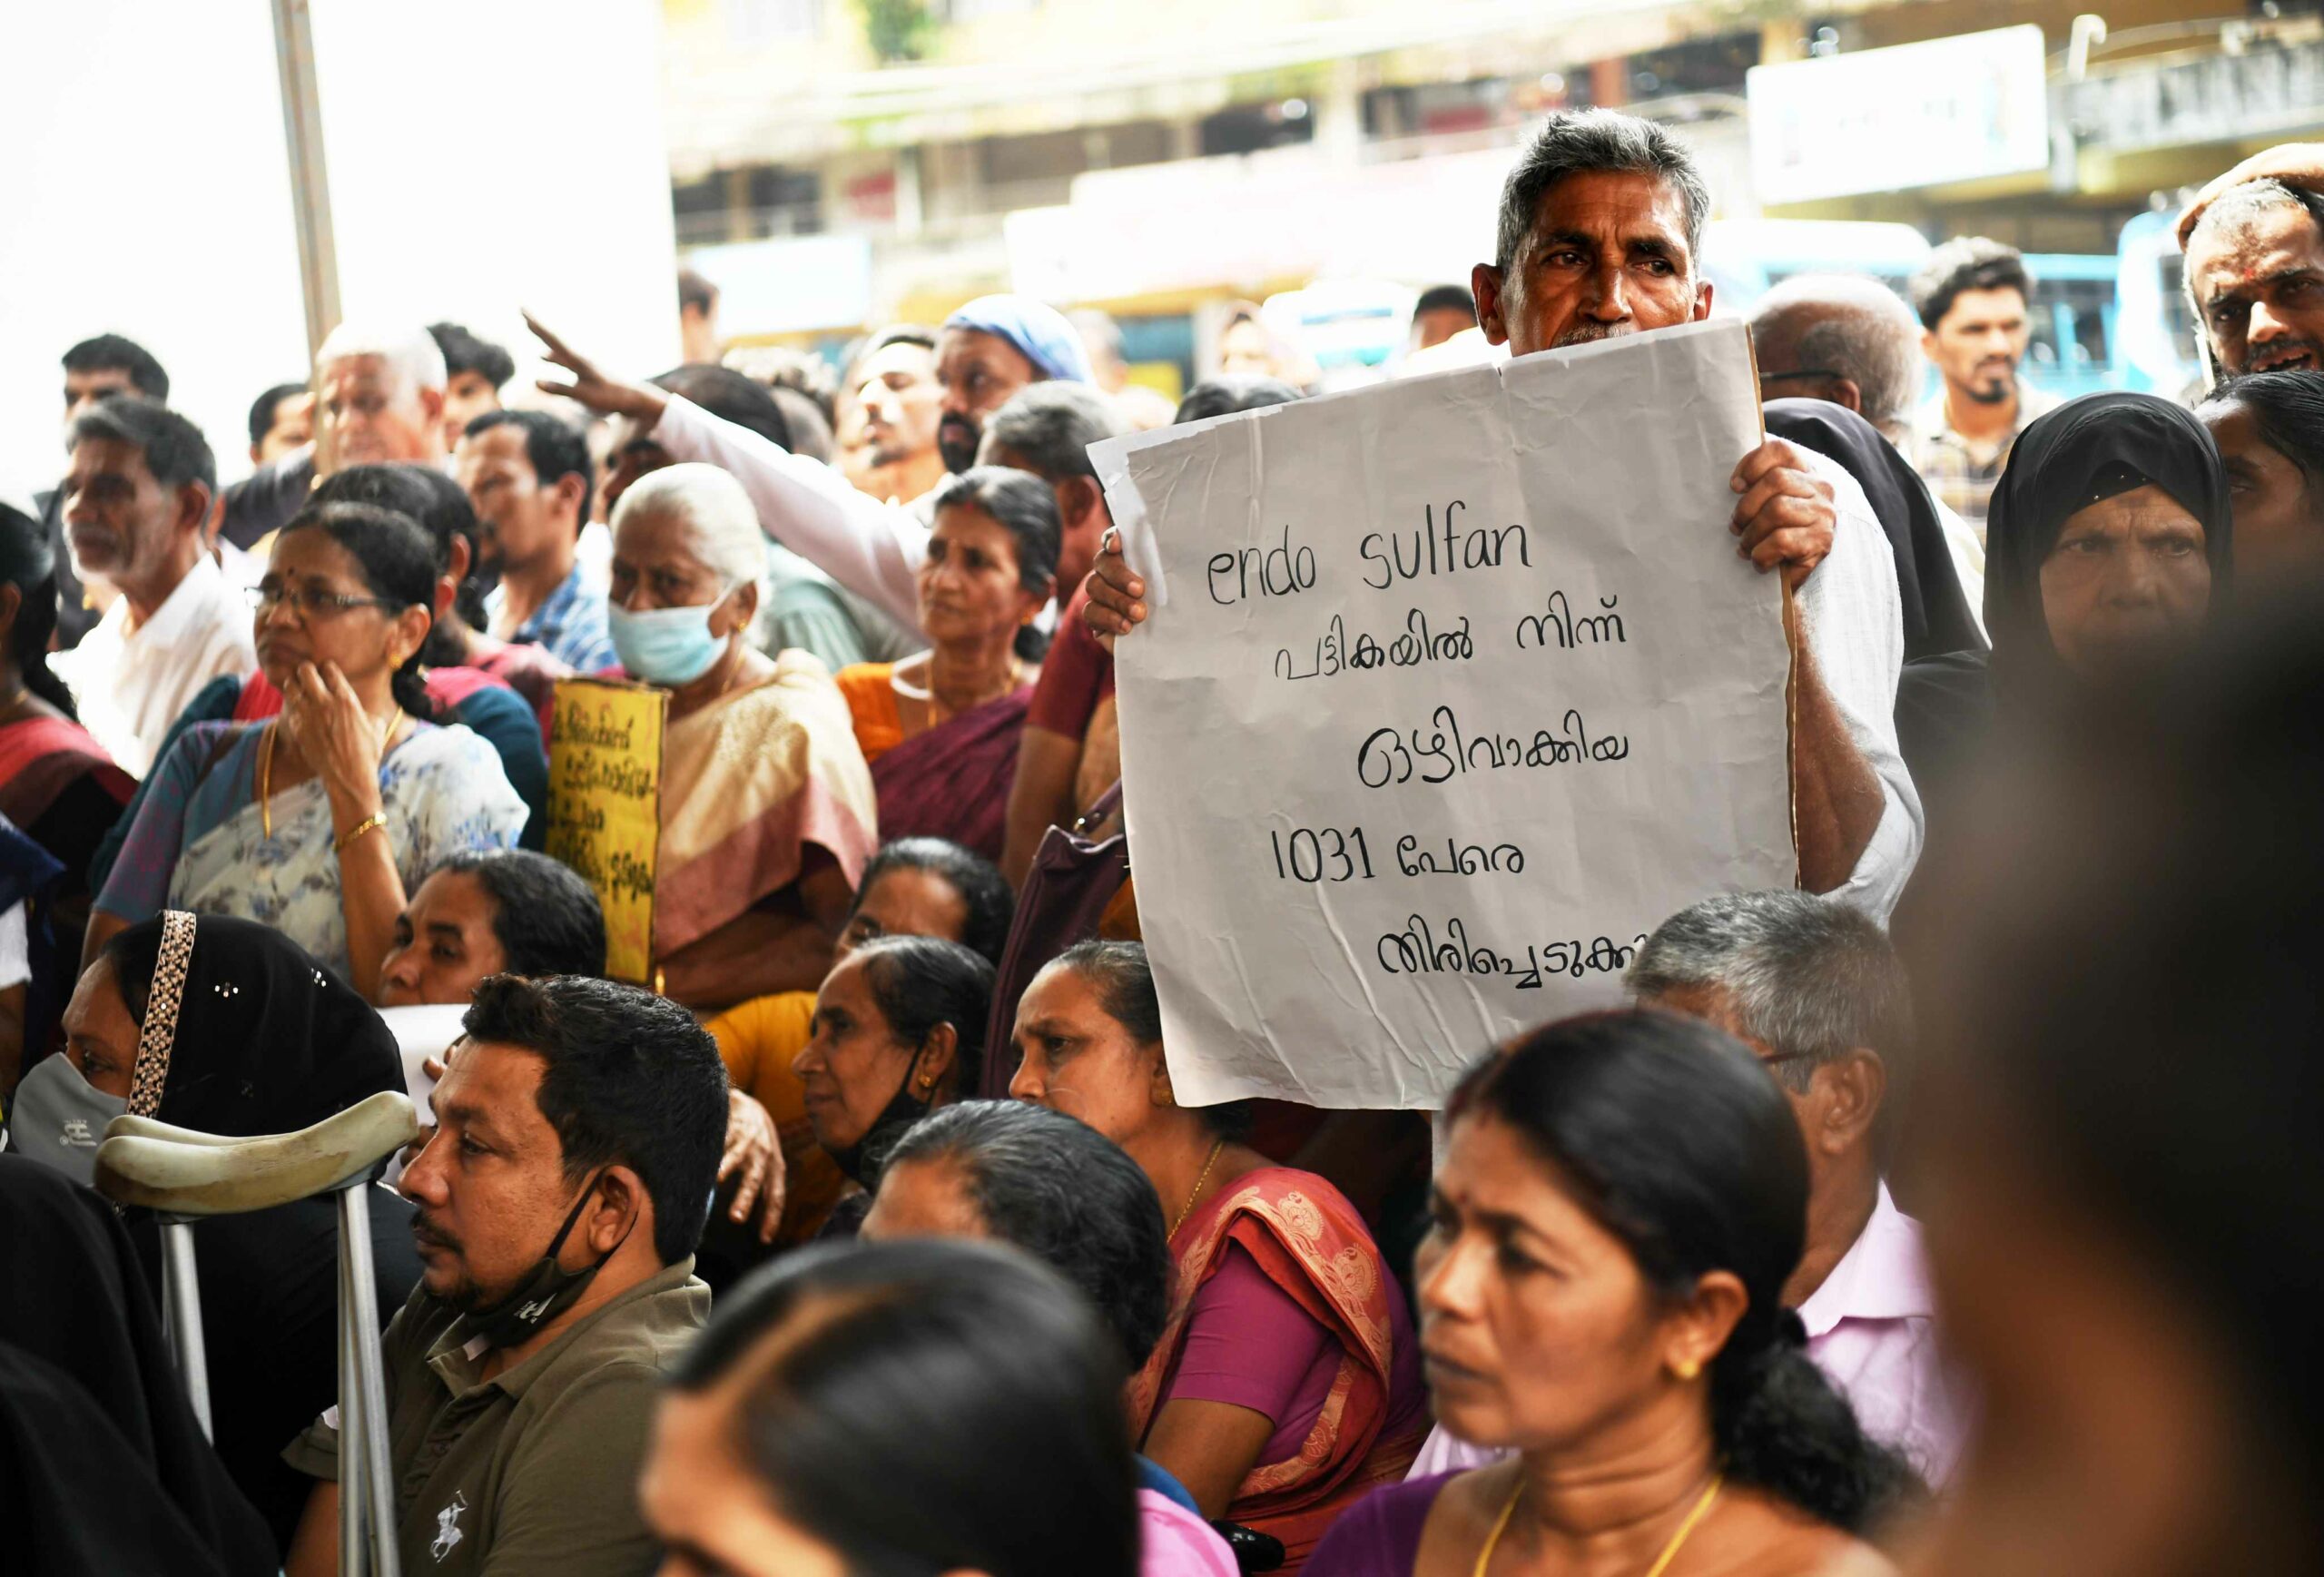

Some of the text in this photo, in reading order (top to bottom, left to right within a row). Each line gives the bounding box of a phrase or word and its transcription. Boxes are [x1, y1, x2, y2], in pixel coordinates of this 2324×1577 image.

[1206, 524, 1317, 606] endo
[1275, 589, 1627, 681] പട്ടികയിൽ നിന്ന്
[1357, 705, 1630, 789] ഒഴിവാക്കിയ
[1271, 826, 1525, 883] 1031 പേരെ
[1376, 912, 1648, 990] തിരിച്ചെടുക്ക
